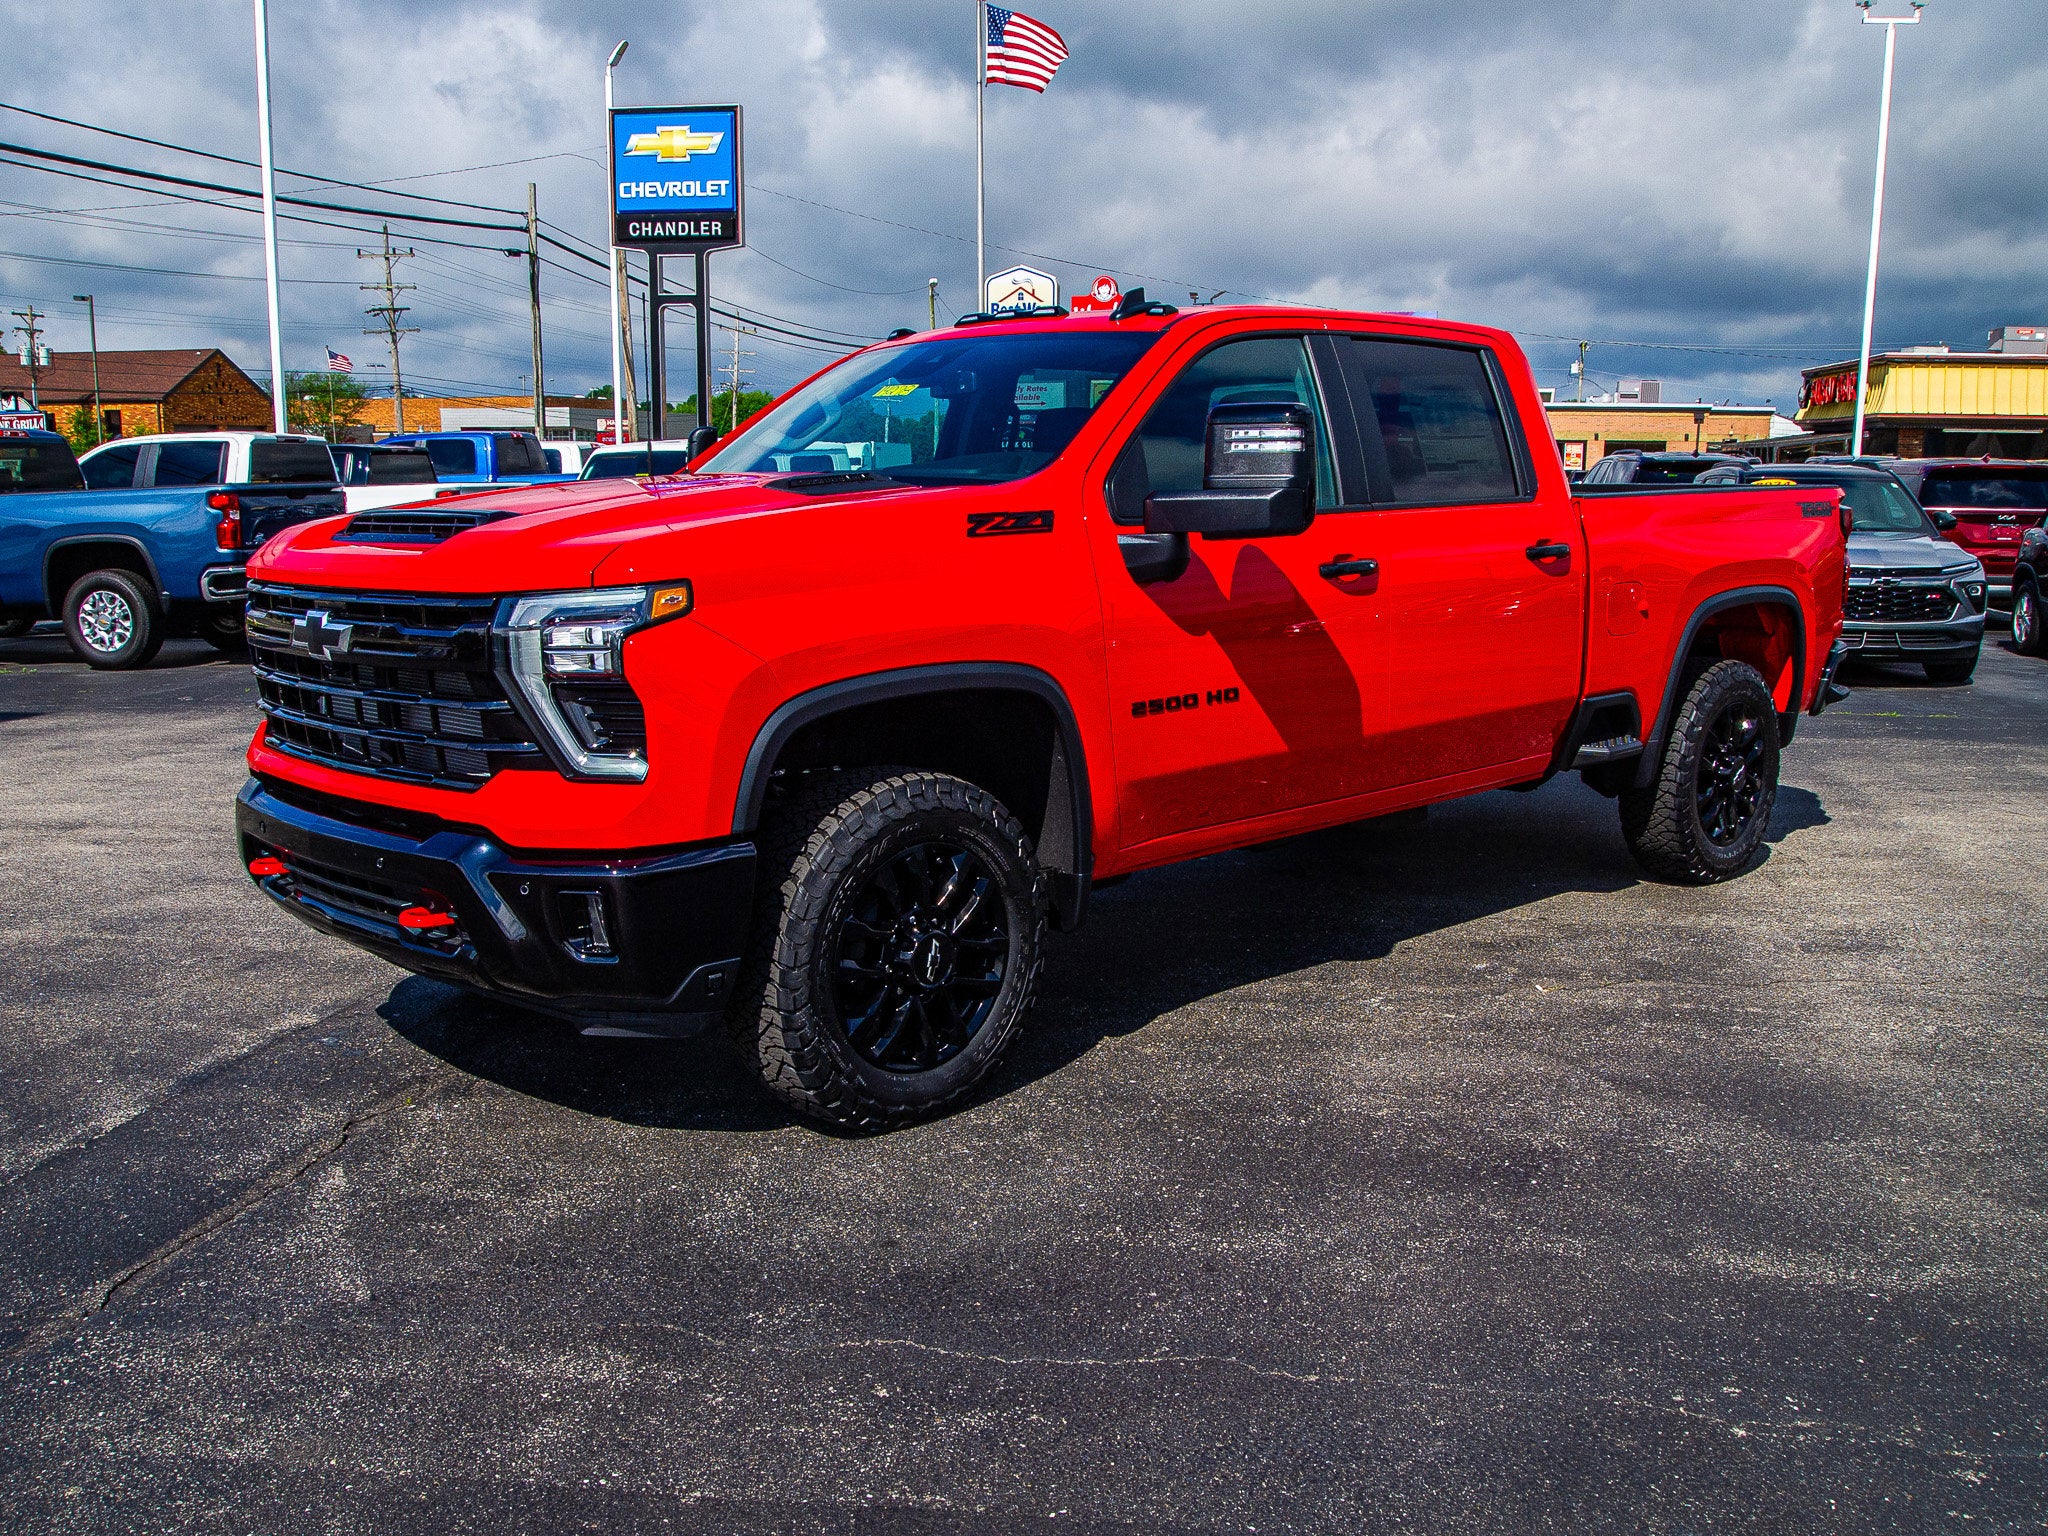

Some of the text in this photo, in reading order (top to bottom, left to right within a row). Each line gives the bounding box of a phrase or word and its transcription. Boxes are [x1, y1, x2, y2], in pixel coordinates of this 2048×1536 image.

[619, 180, 730, 198] CHEVROLET
[629, 221, 722, 236] CHANDLER
[1131, 687, 1240, 718] 2500 HD
